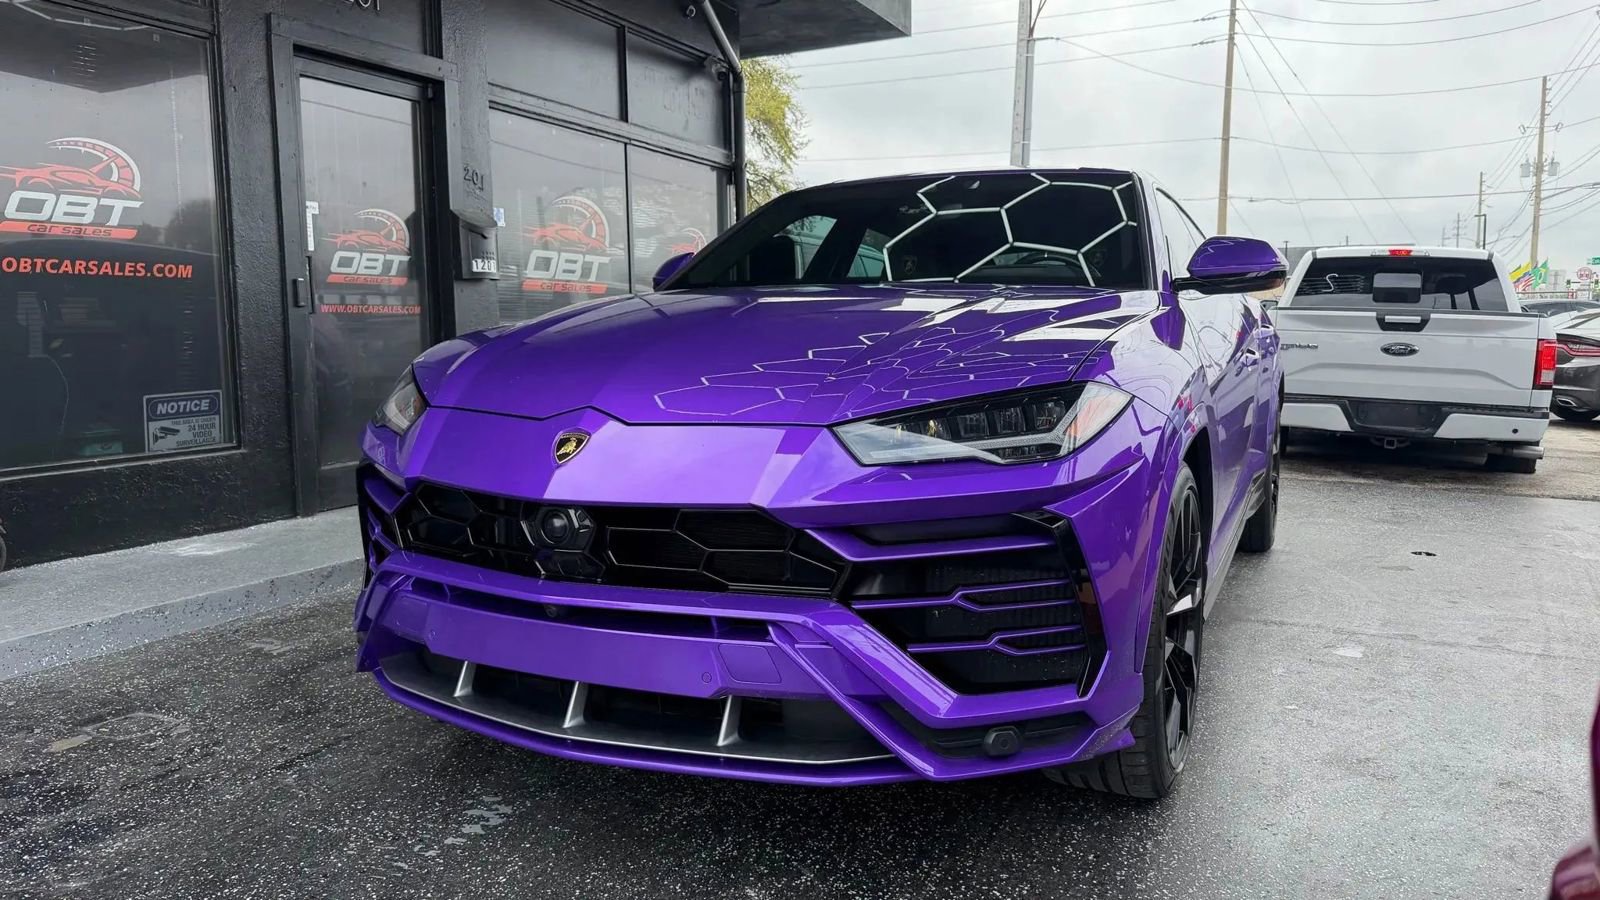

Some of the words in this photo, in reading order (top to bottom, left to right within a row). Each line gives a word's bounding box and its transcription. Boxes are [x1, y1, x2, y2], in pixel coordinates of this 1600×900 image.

[4, 190, 144, 226] OBT
[27, 223, 57, 234] car
[62, 226, 112, 237] sales
[1, 256, 193, 279] OBTCARSALES.COM
[330, 250, 412, 276] OBT
[526, 249, 612, 282] OBT
[541, 281, 560, 291] car
[320, 304, 422, 315] WWW.OBTCARSALES.COM
[156, 399, 210, 415] NOTICE
[176, 436, 216, 447] SURVEILLAE
